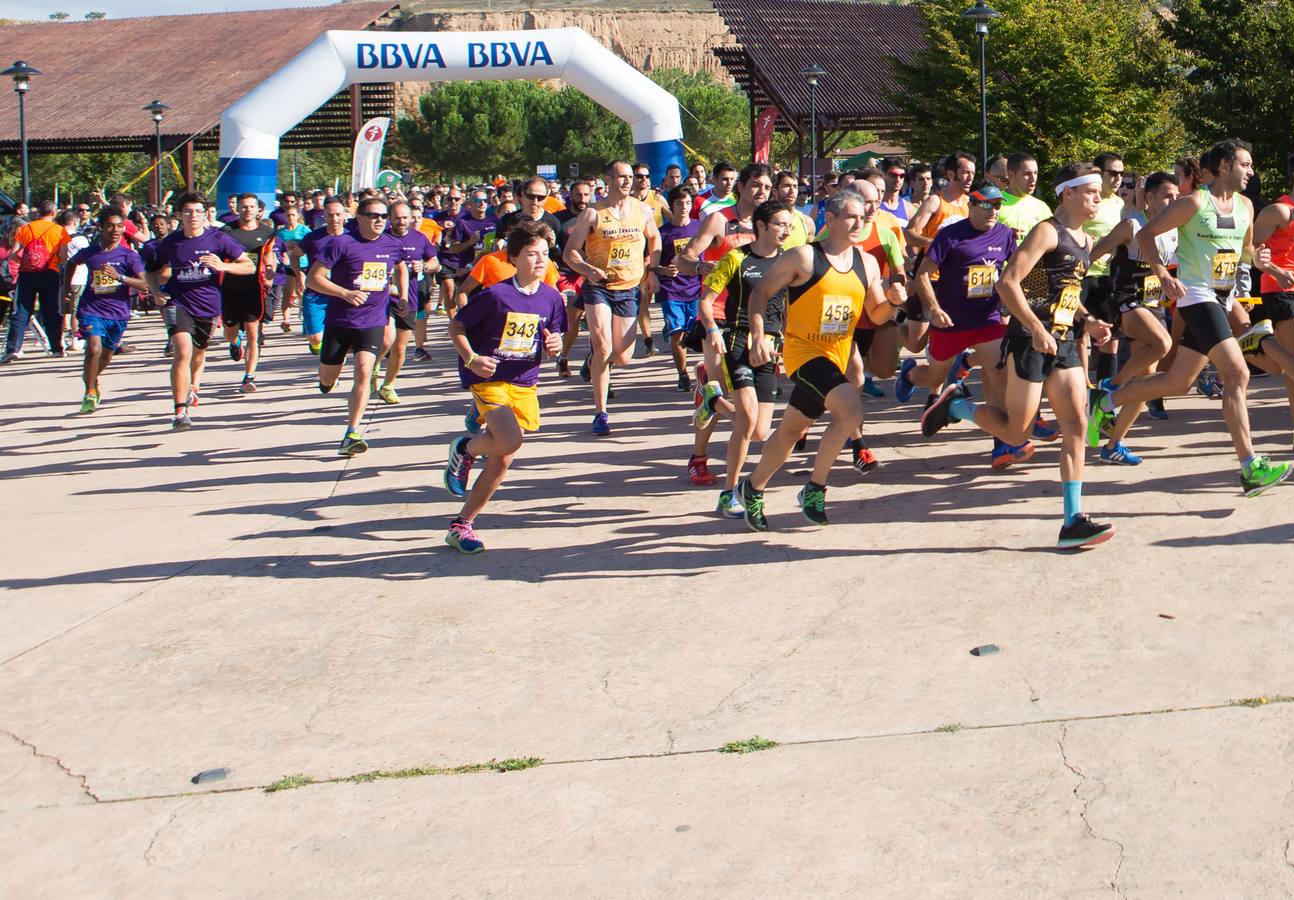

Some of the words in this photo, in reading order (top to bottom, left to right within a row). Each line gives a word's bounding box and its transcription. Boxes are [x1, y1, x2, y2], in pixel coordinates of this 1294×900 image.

[357, 43, 448, 69] BBVA
[467, 41, 554, 68] BBVA
[611, 247, 631, 260] 304
[364, 268, 385, 281] 349
[1215, 261, 1236, 276] 479
[95, 275, 115, 286] 359
[971, 271, 992, 286] 611
[1060, 293, 1078, 311] 623
[824, 304, 850, 322] 458
[506, 321, 536, 338] 343
